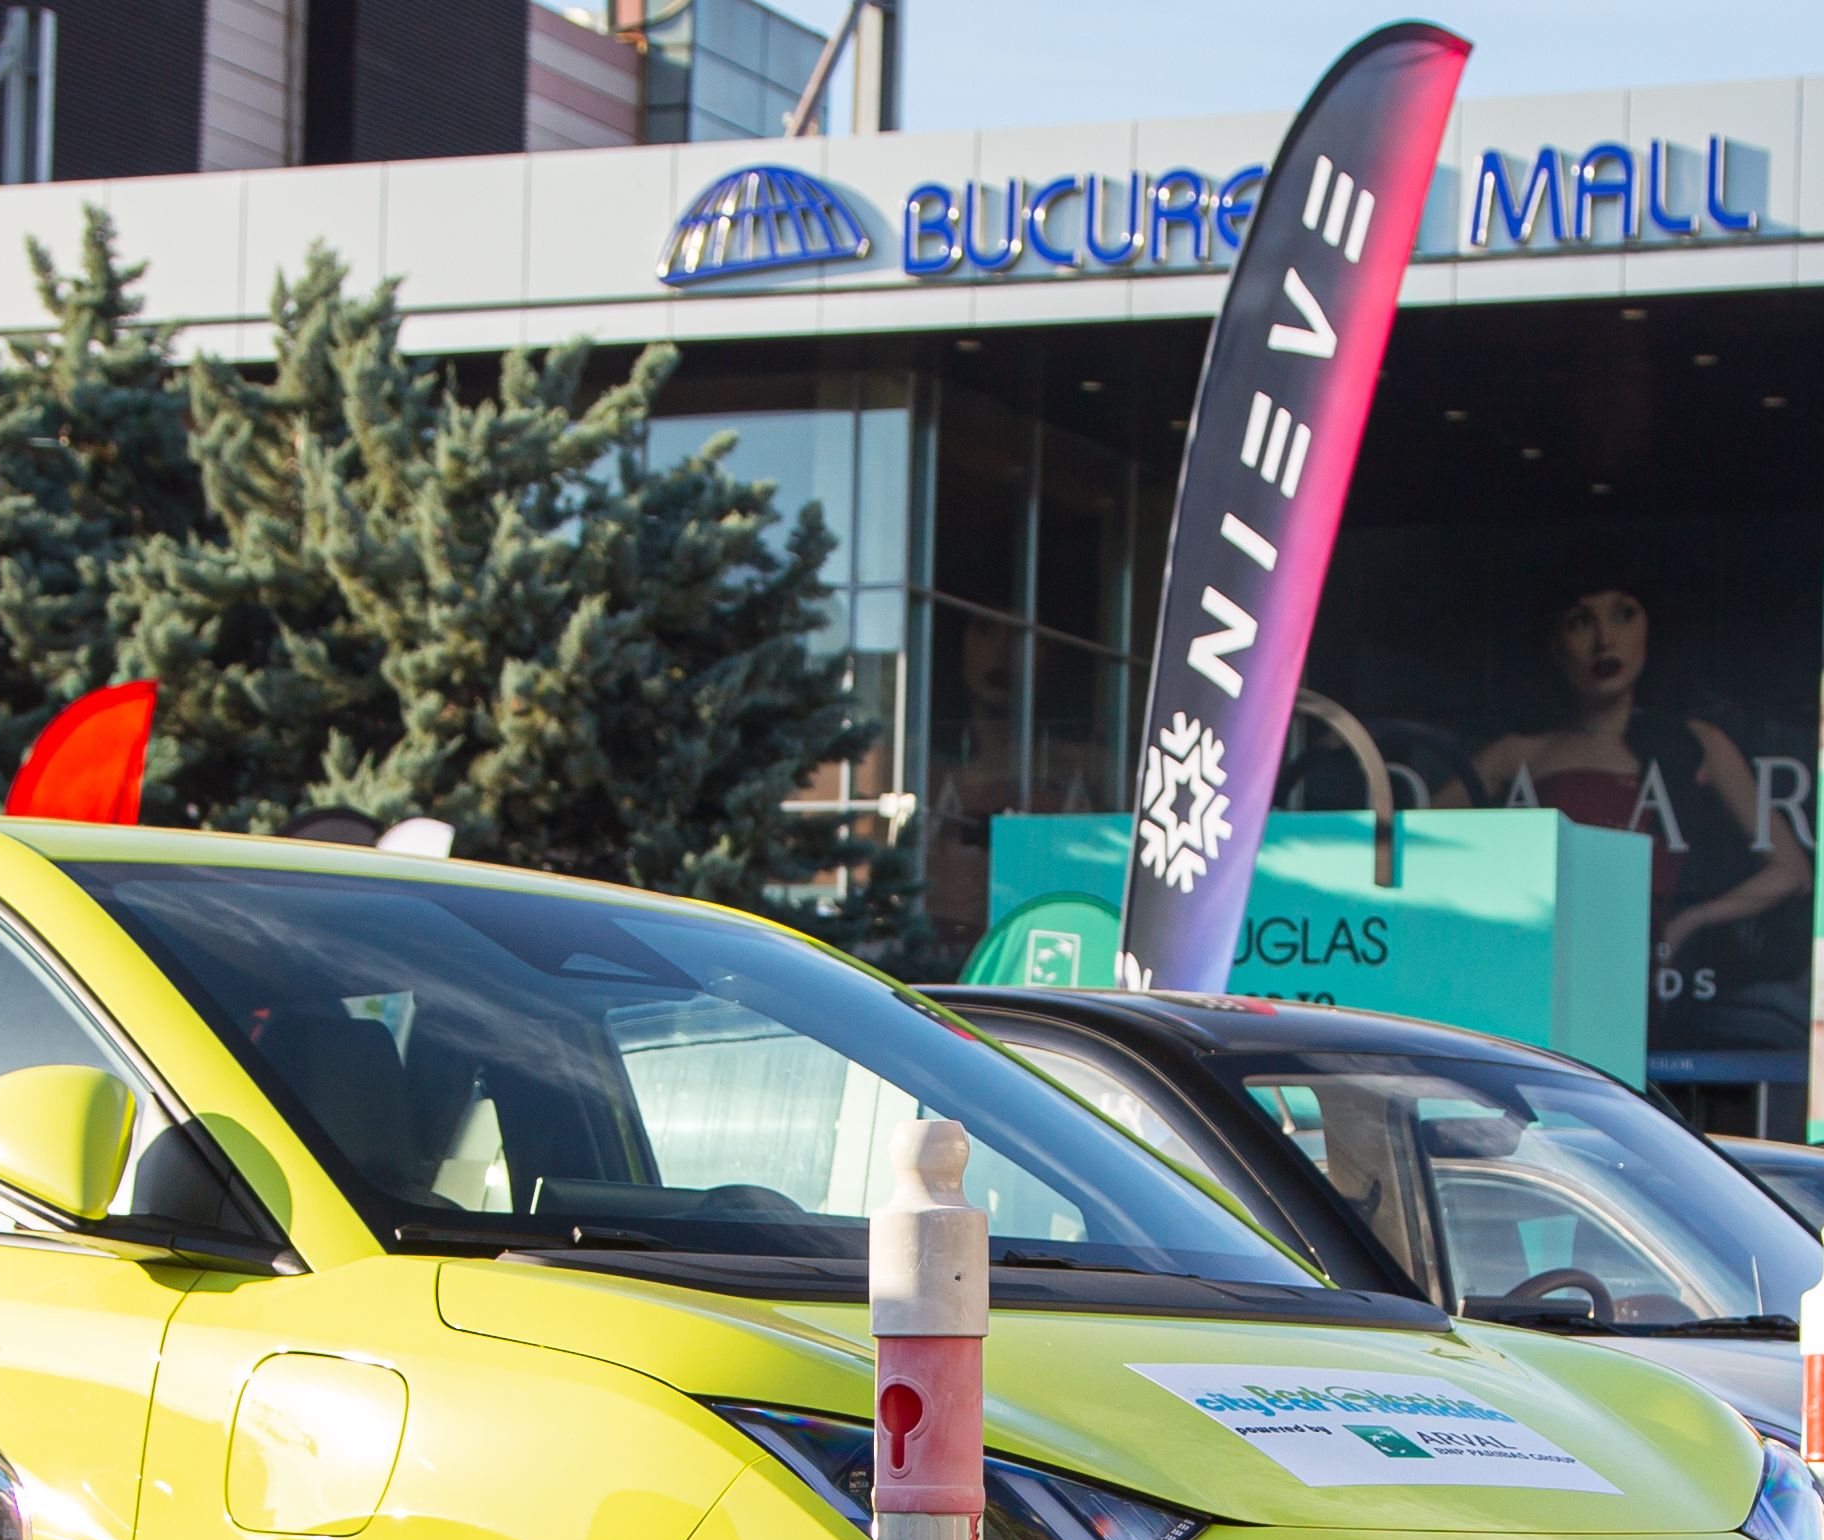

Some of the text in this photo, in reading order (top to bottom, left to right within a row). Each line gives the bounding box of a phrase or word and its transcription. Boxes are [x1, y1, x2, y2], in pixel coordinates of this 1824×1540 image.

[900, 133, 1759, 276] BUCURE MALL
[1186, 154, 1375, 699] NIEVE
[1231, 917, 1389, 966] UGLAS
[1195, 1392, 1276, 1417] city
[1235, 1424, 1333, 1436] powered by
[1417, 1430, 1519, 1449] ARVAL
[1435, 1447, 1578, 1464] BNP PARIBAS GROUP
